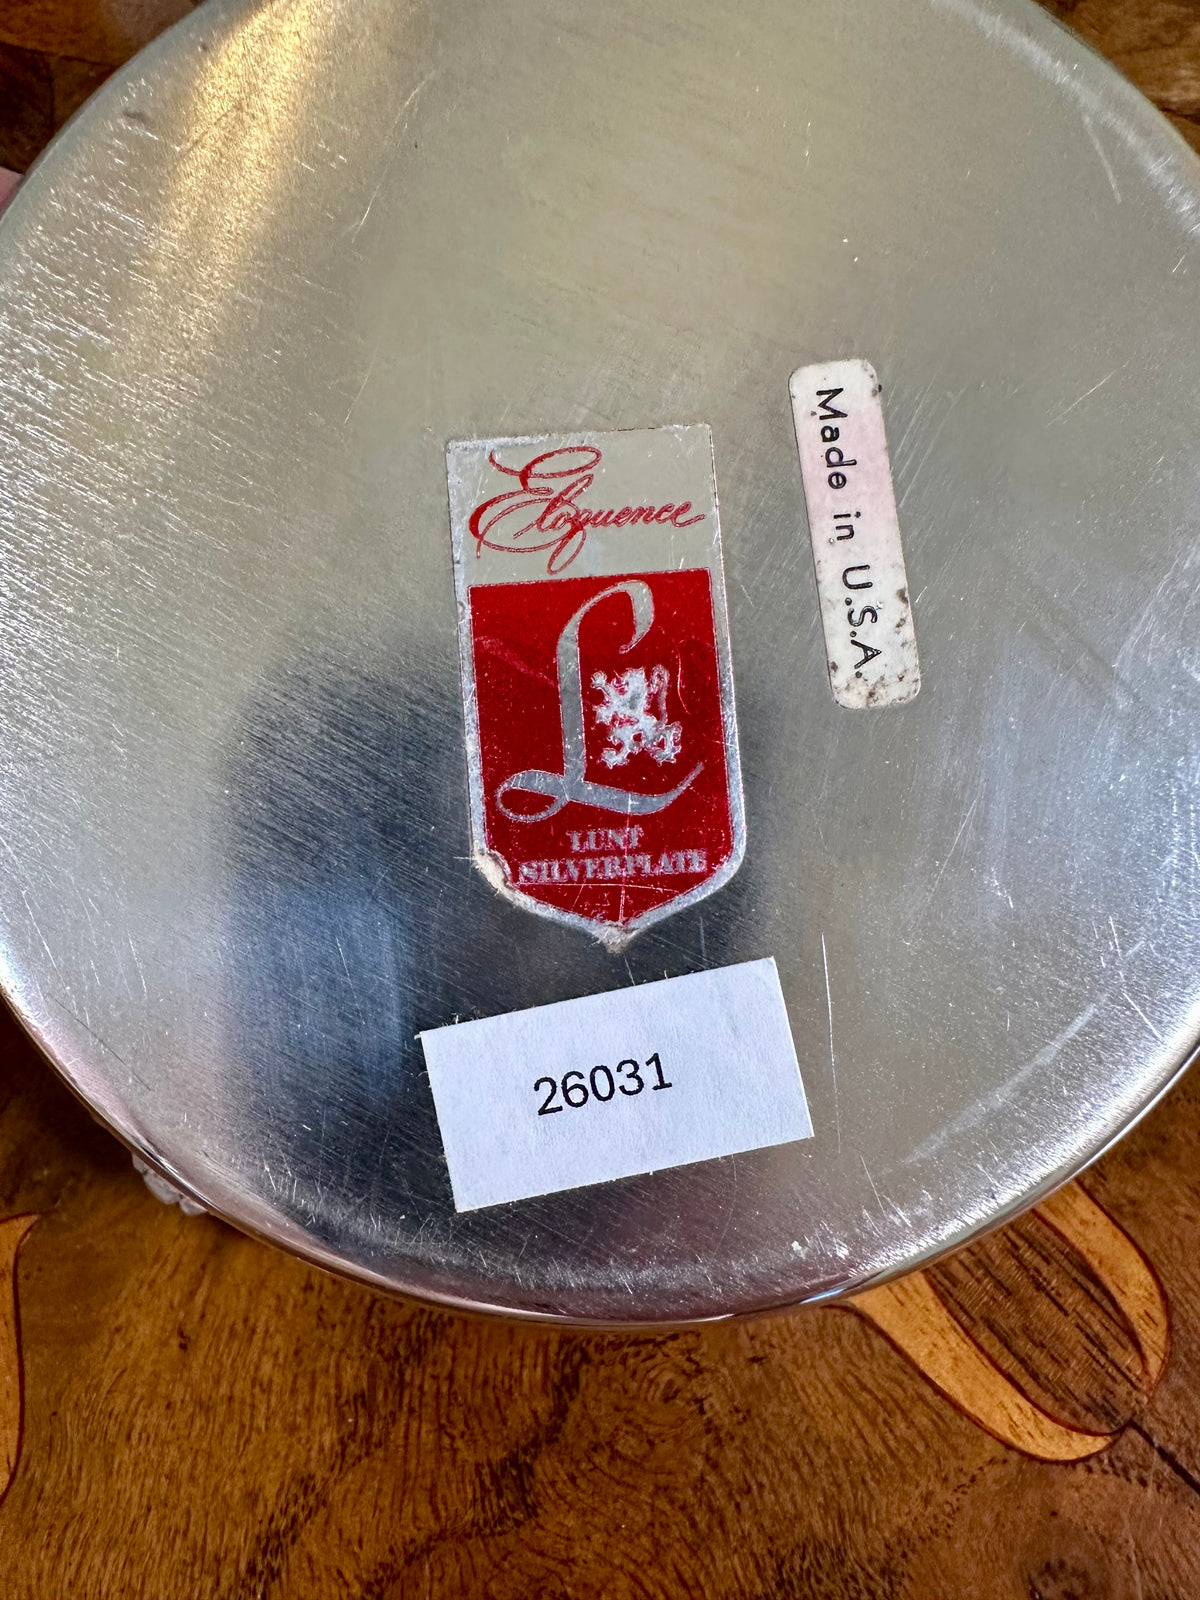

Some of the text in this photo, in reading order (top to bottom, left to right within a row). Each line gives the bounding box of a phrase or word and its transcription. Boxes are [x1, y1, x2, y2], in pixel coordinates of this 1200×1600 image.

[816, 387, 858, 490] Made
[469, 446, 706, 575] Eloquence
[833, 511, 862, 541] in
[496, 579, 705, 823] L
[518, 849, 708, 884] SILVERPLATE
[566, 826, 645, 852] LUNT
[533, 1052, 673, 1116] 26031
